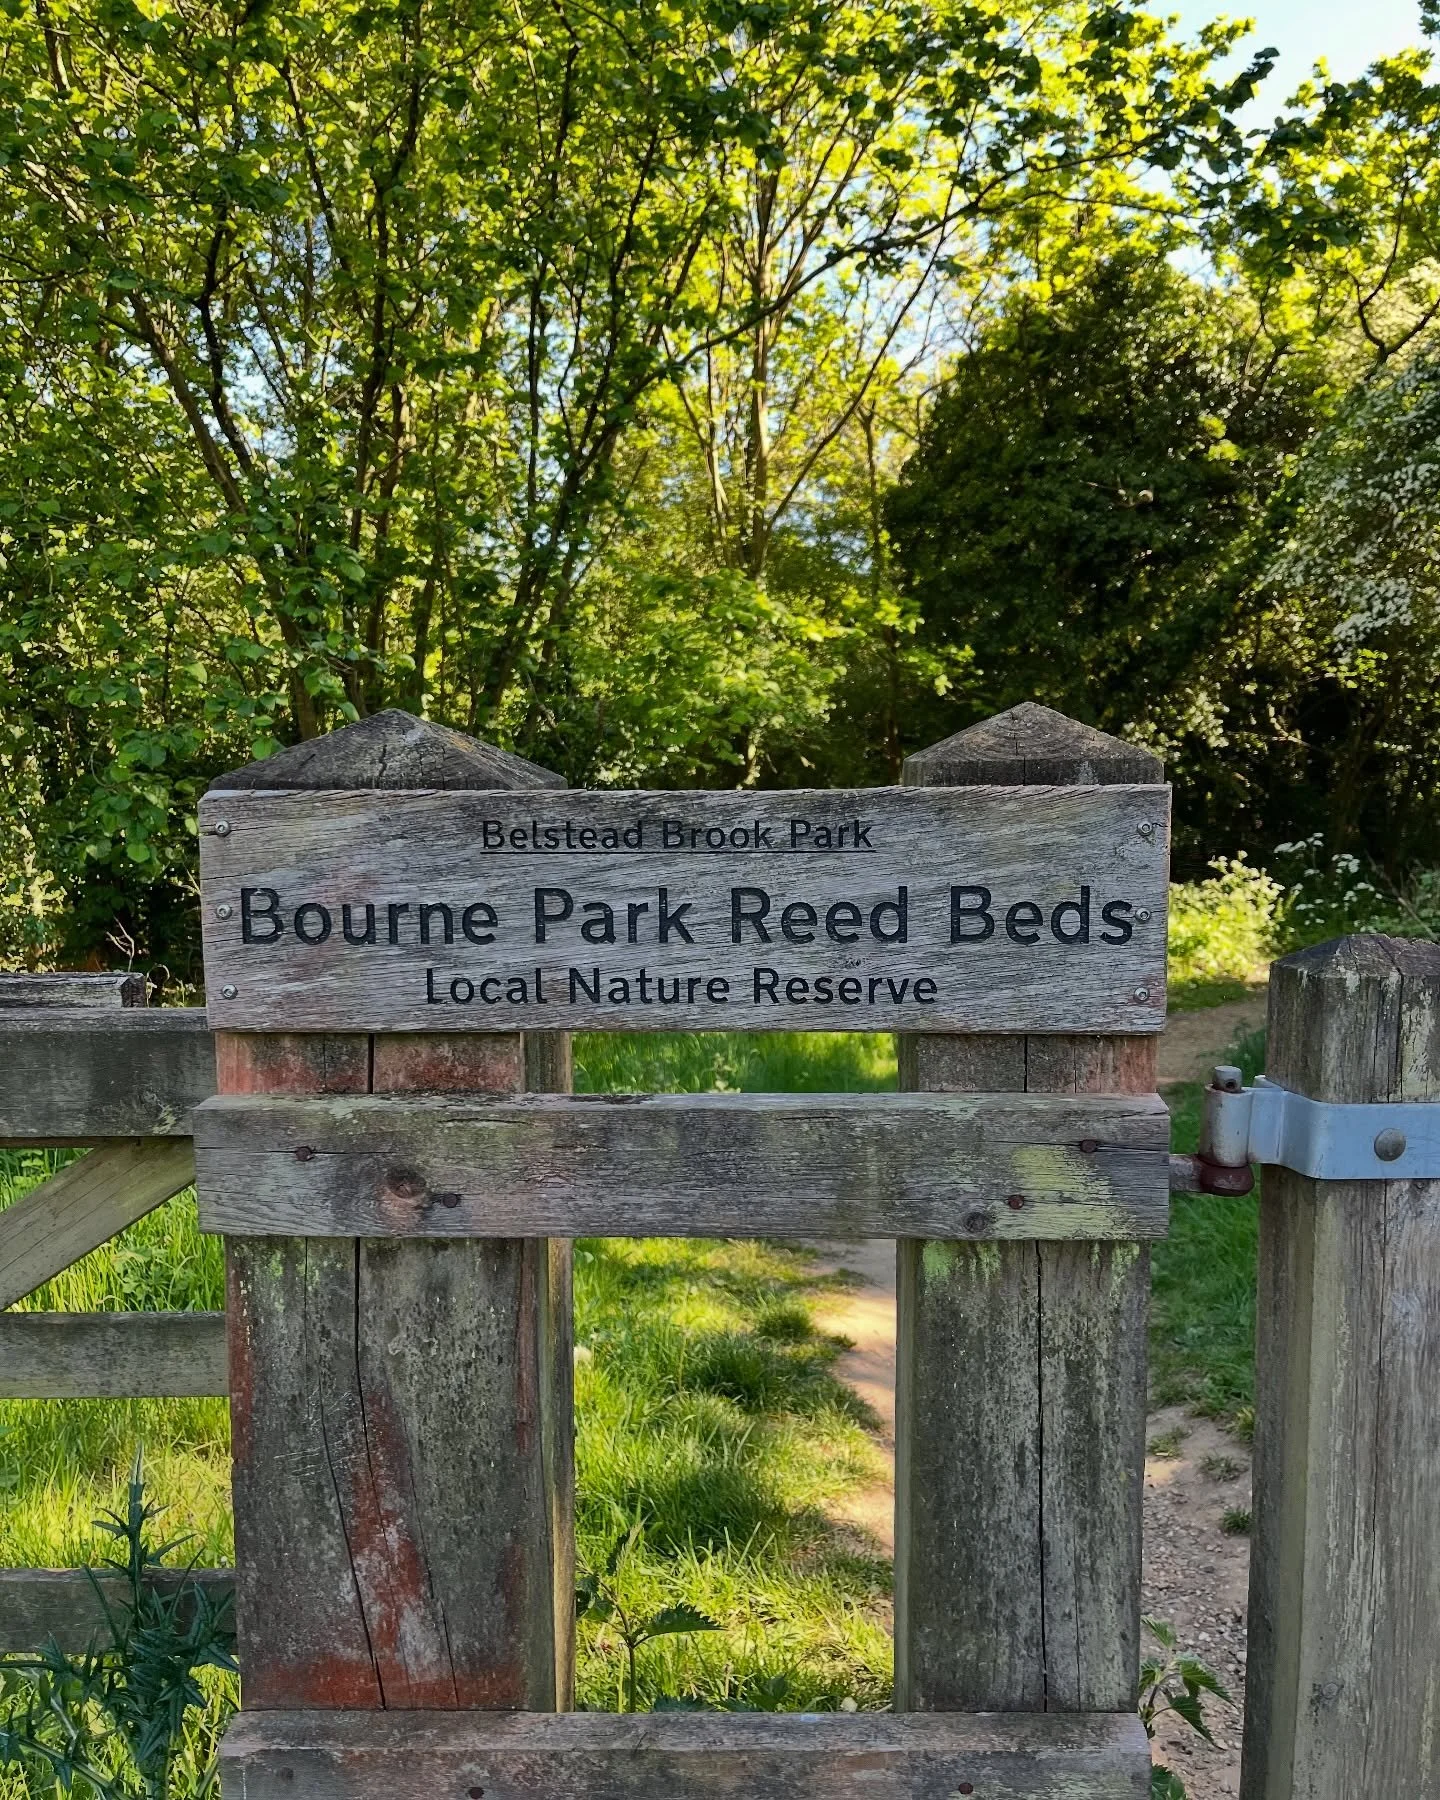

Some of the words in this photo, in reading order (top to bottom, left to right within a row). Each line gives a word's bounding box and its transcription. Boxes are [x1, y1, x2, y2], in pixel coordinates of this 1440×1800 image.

[482, 820, 643, 850] Belstead
[662, 819, 774, 850] Brook
[790, 819, 874, 849] Park
[240, 887, 499, 945] Bourne
[534, 887, 695, 944] Park
[730, 886, 908, 944] Reed
[950, 885, 1134, 945] Beds
[426, 967, 544, 1004] Local
[568, 967, 731, 1004] Nature
[753, 967, 938, 1004] Reserve
